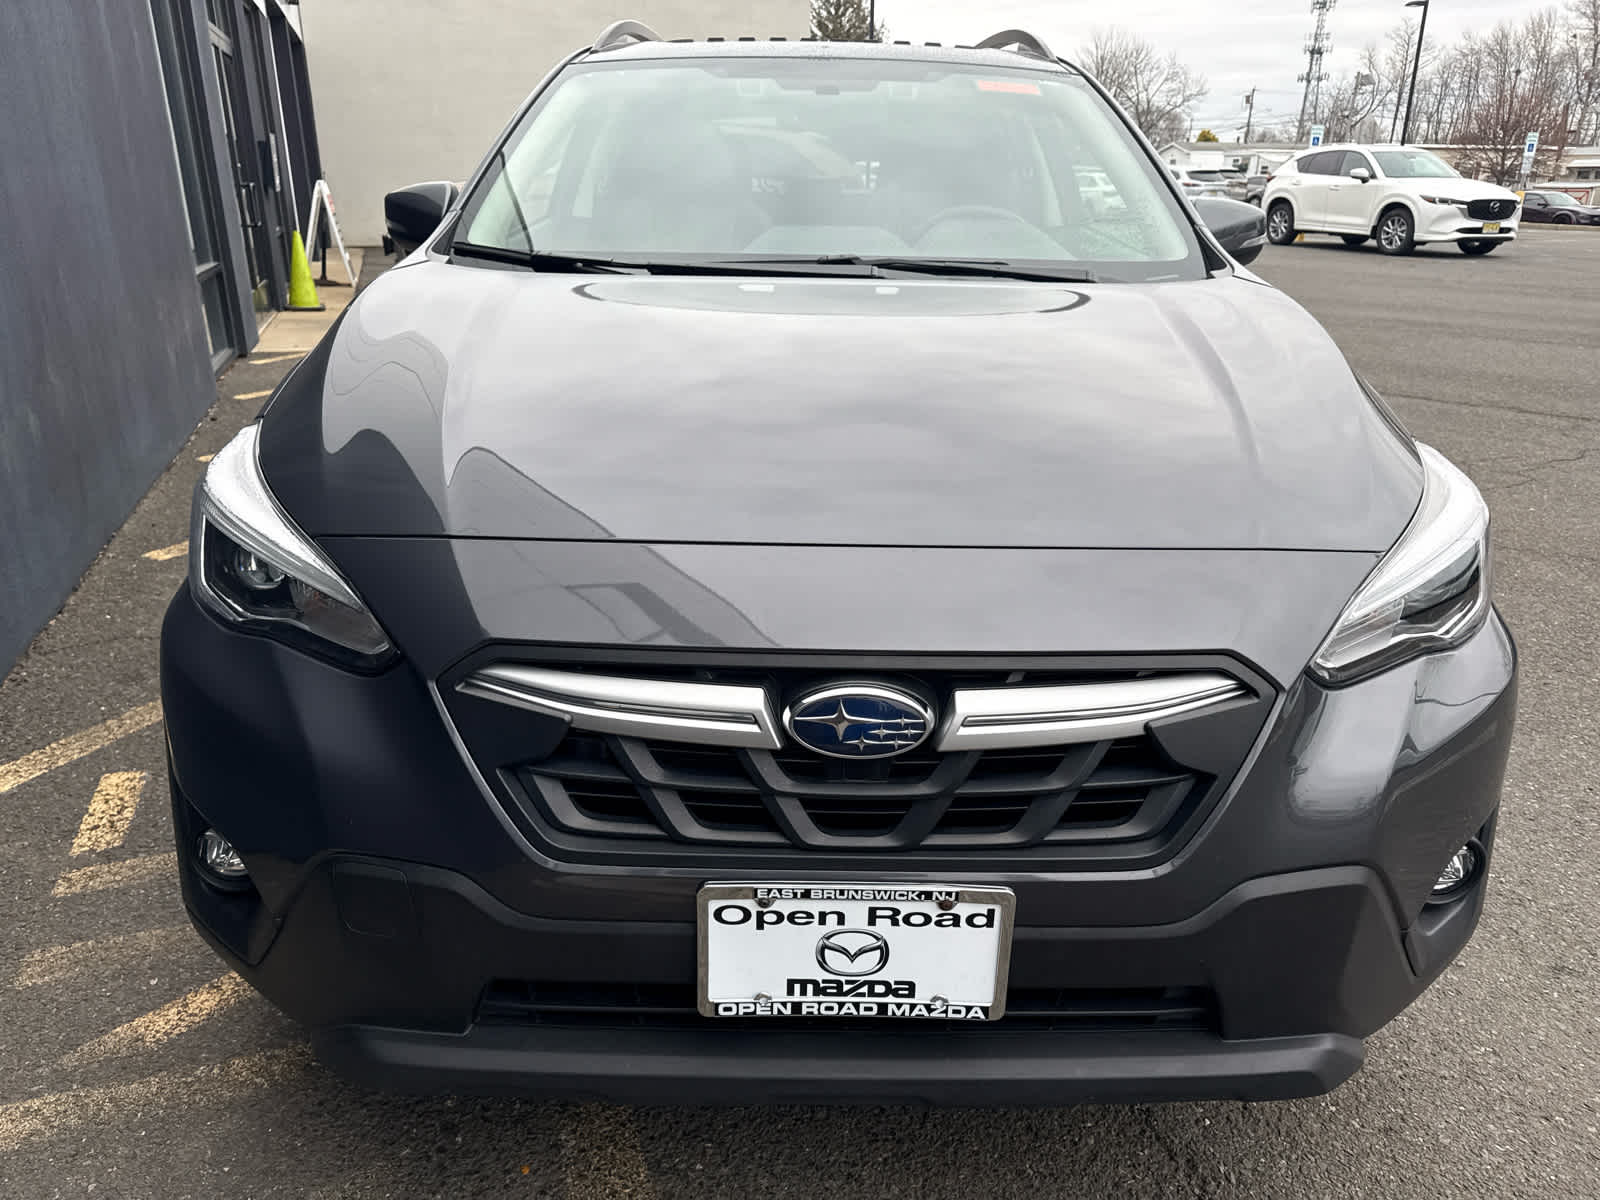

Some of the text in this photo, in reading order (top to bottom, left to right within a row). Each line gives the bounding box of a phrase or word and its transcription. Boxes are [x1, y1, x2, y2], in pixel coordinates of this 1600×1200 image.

[757, 888, 804, 900] EAST
[932, 892, 956, 902] NJ
[713, 904, 996, 930] Open Road
[718, 1002, 986, 1020] OPEN ROAD MAZDA
